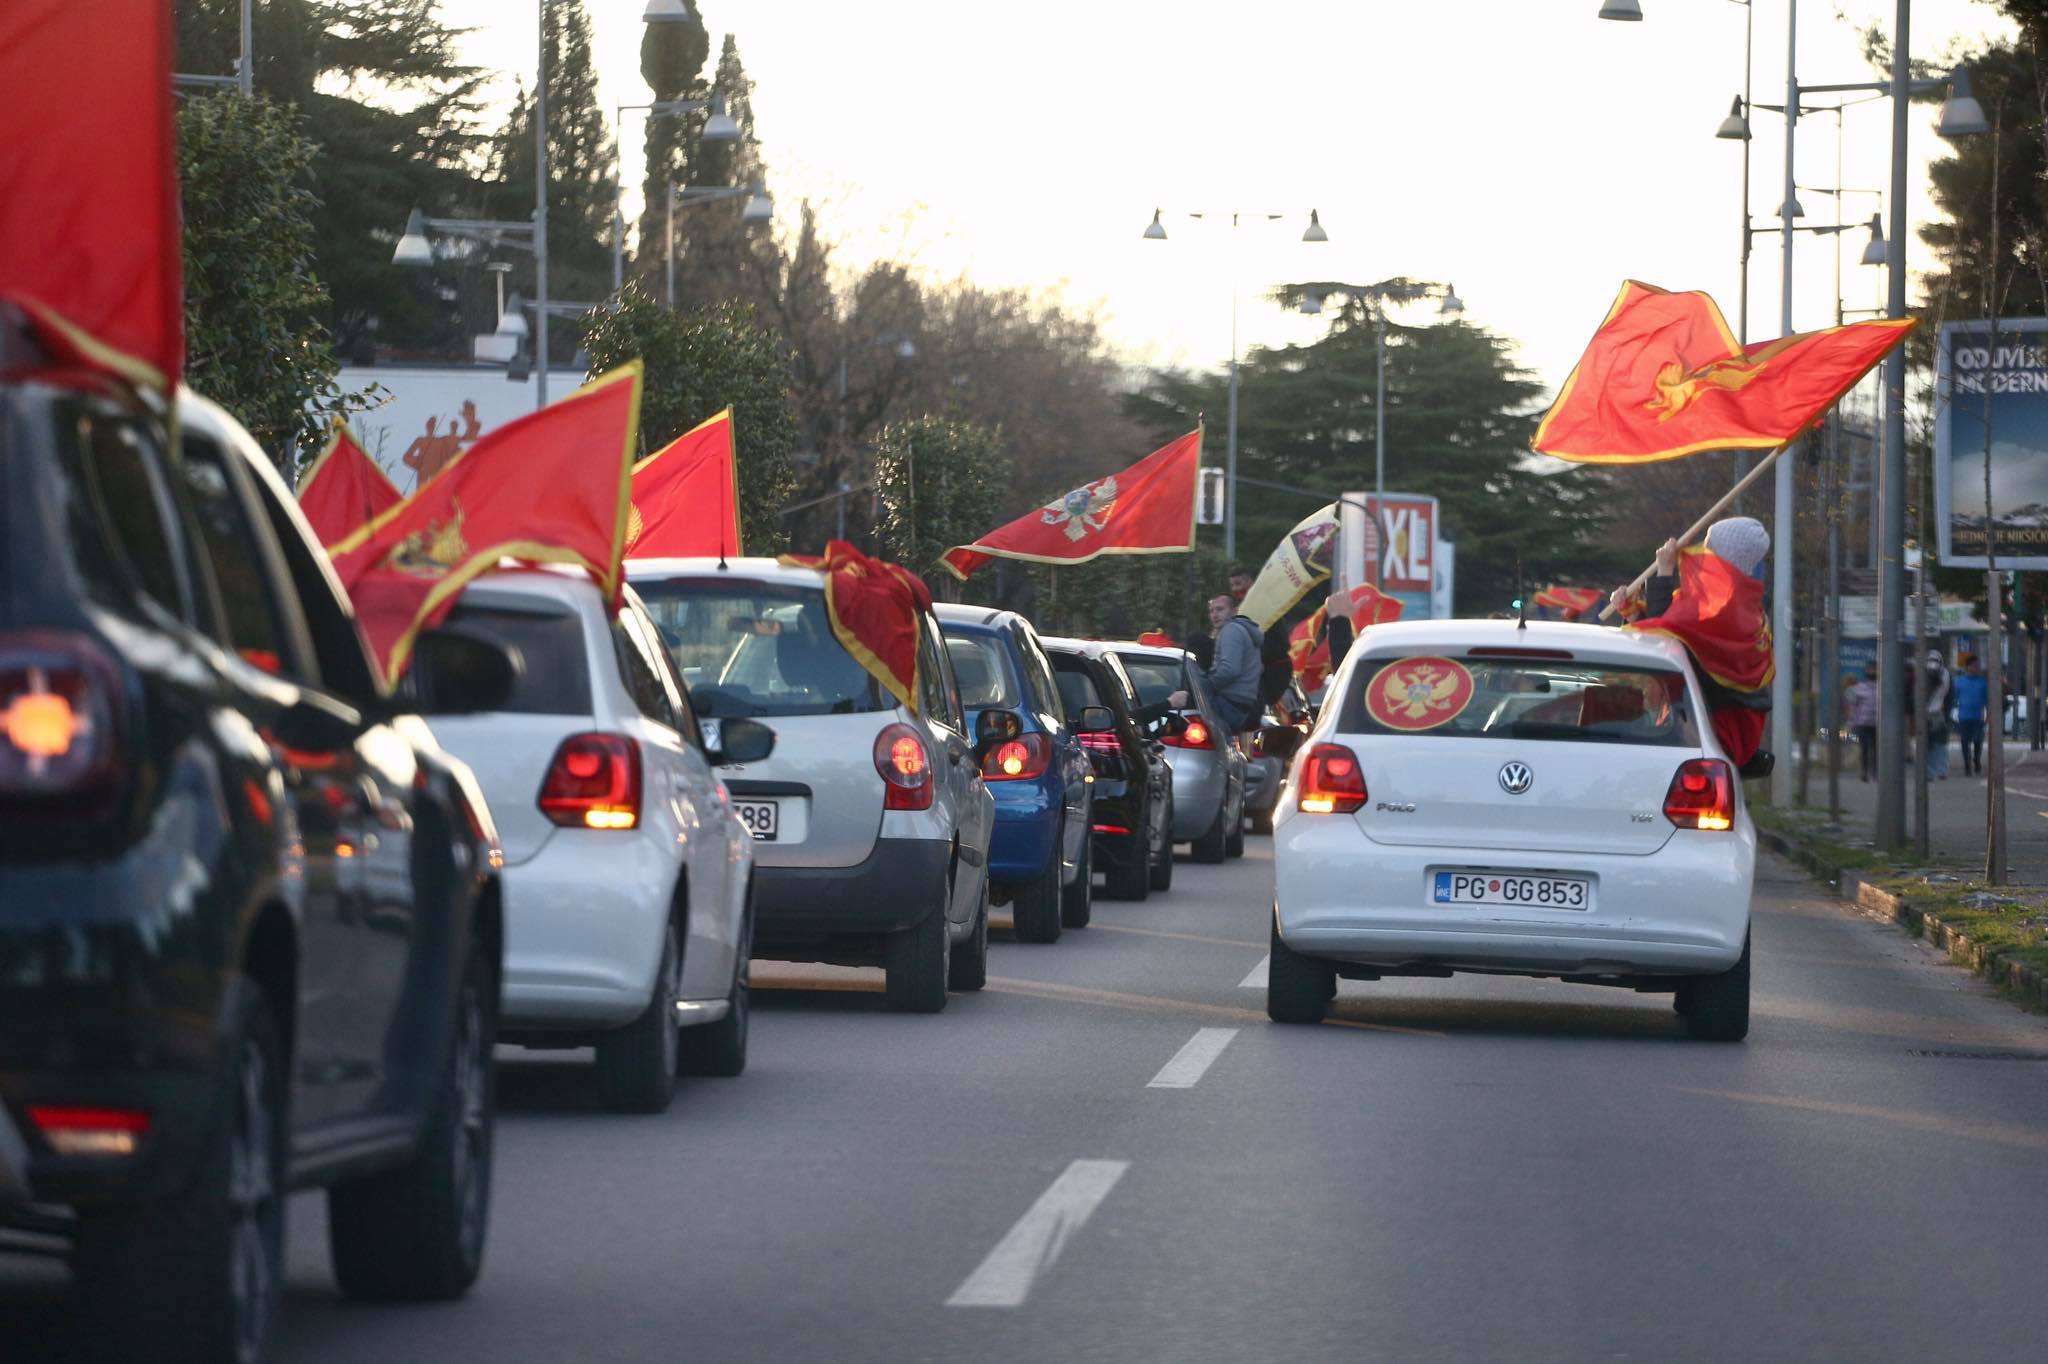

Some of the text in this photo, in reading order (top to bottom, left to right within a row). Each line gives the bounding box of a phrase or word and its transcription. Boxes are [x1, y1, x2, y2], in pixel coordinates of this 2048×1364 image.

[1383, 507, 1429, 580] XL
[734, 805, 771, 831] 88
[1454, 876, 1485, 899] PG
